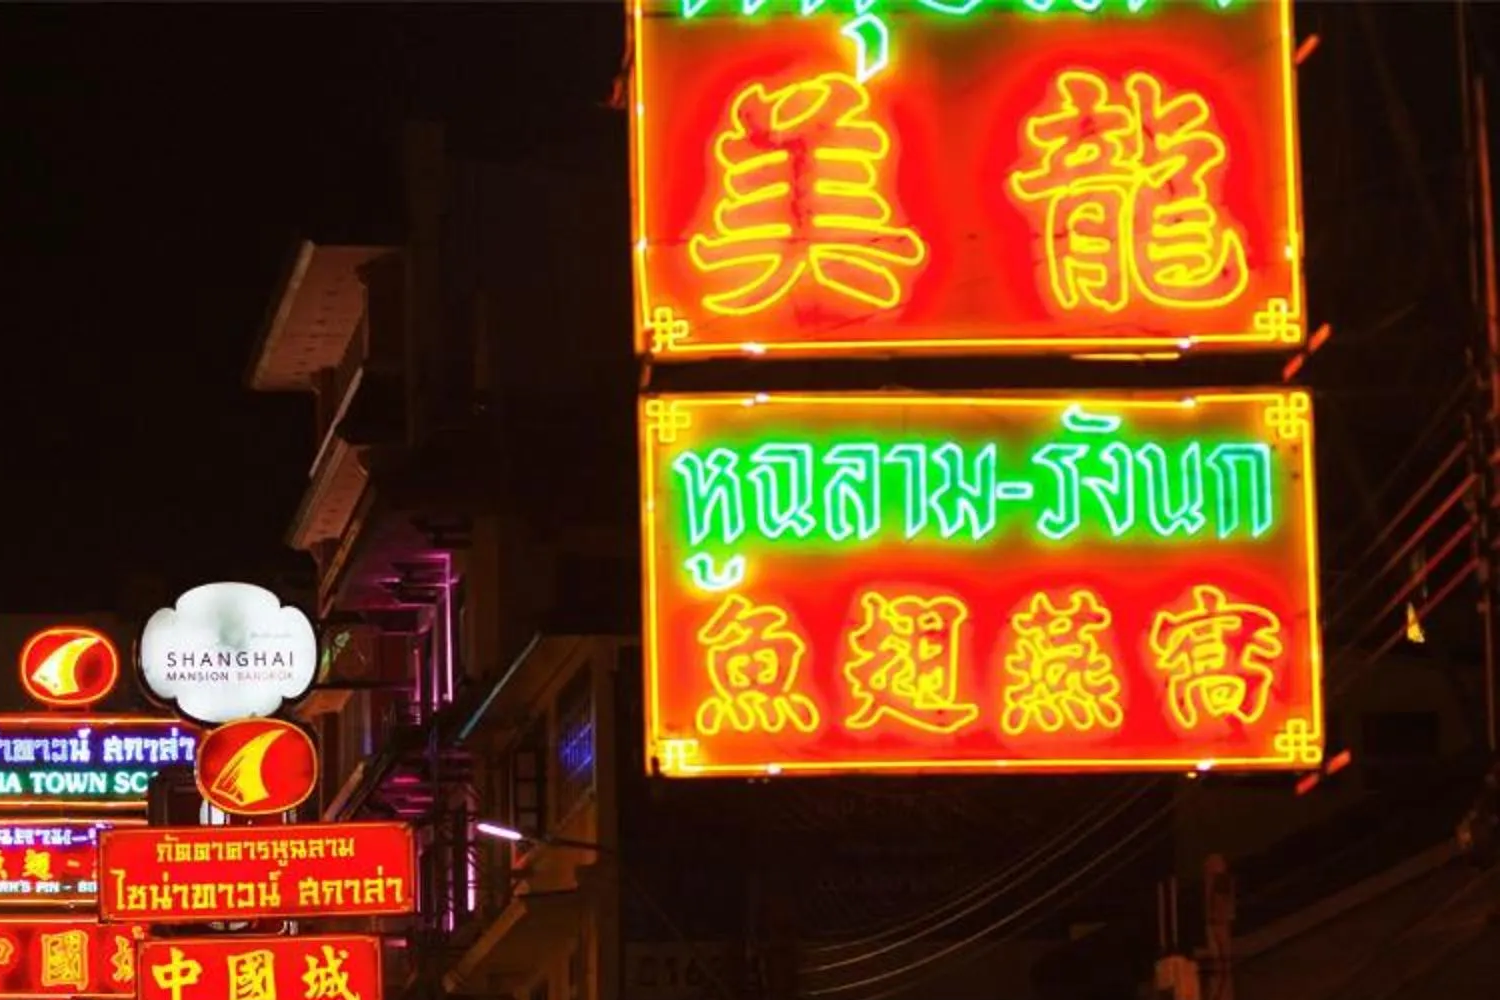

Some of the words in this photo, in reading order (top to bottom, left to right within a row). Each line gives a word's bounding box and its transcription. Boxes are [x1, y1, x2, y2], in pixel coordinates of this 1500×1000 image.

[688, 70, 1249, 314] 美龍
[166, 651, 294, 667] SHANGHAI
[165, 671, 229, 681] MANSION
[29, 771, 107, 793] TOWN
[113, 771, 149, 793] SC
[110, 867, 282, 910] ไชน่าทาวน์
[297, 865, 404, 907] สกาล่า
